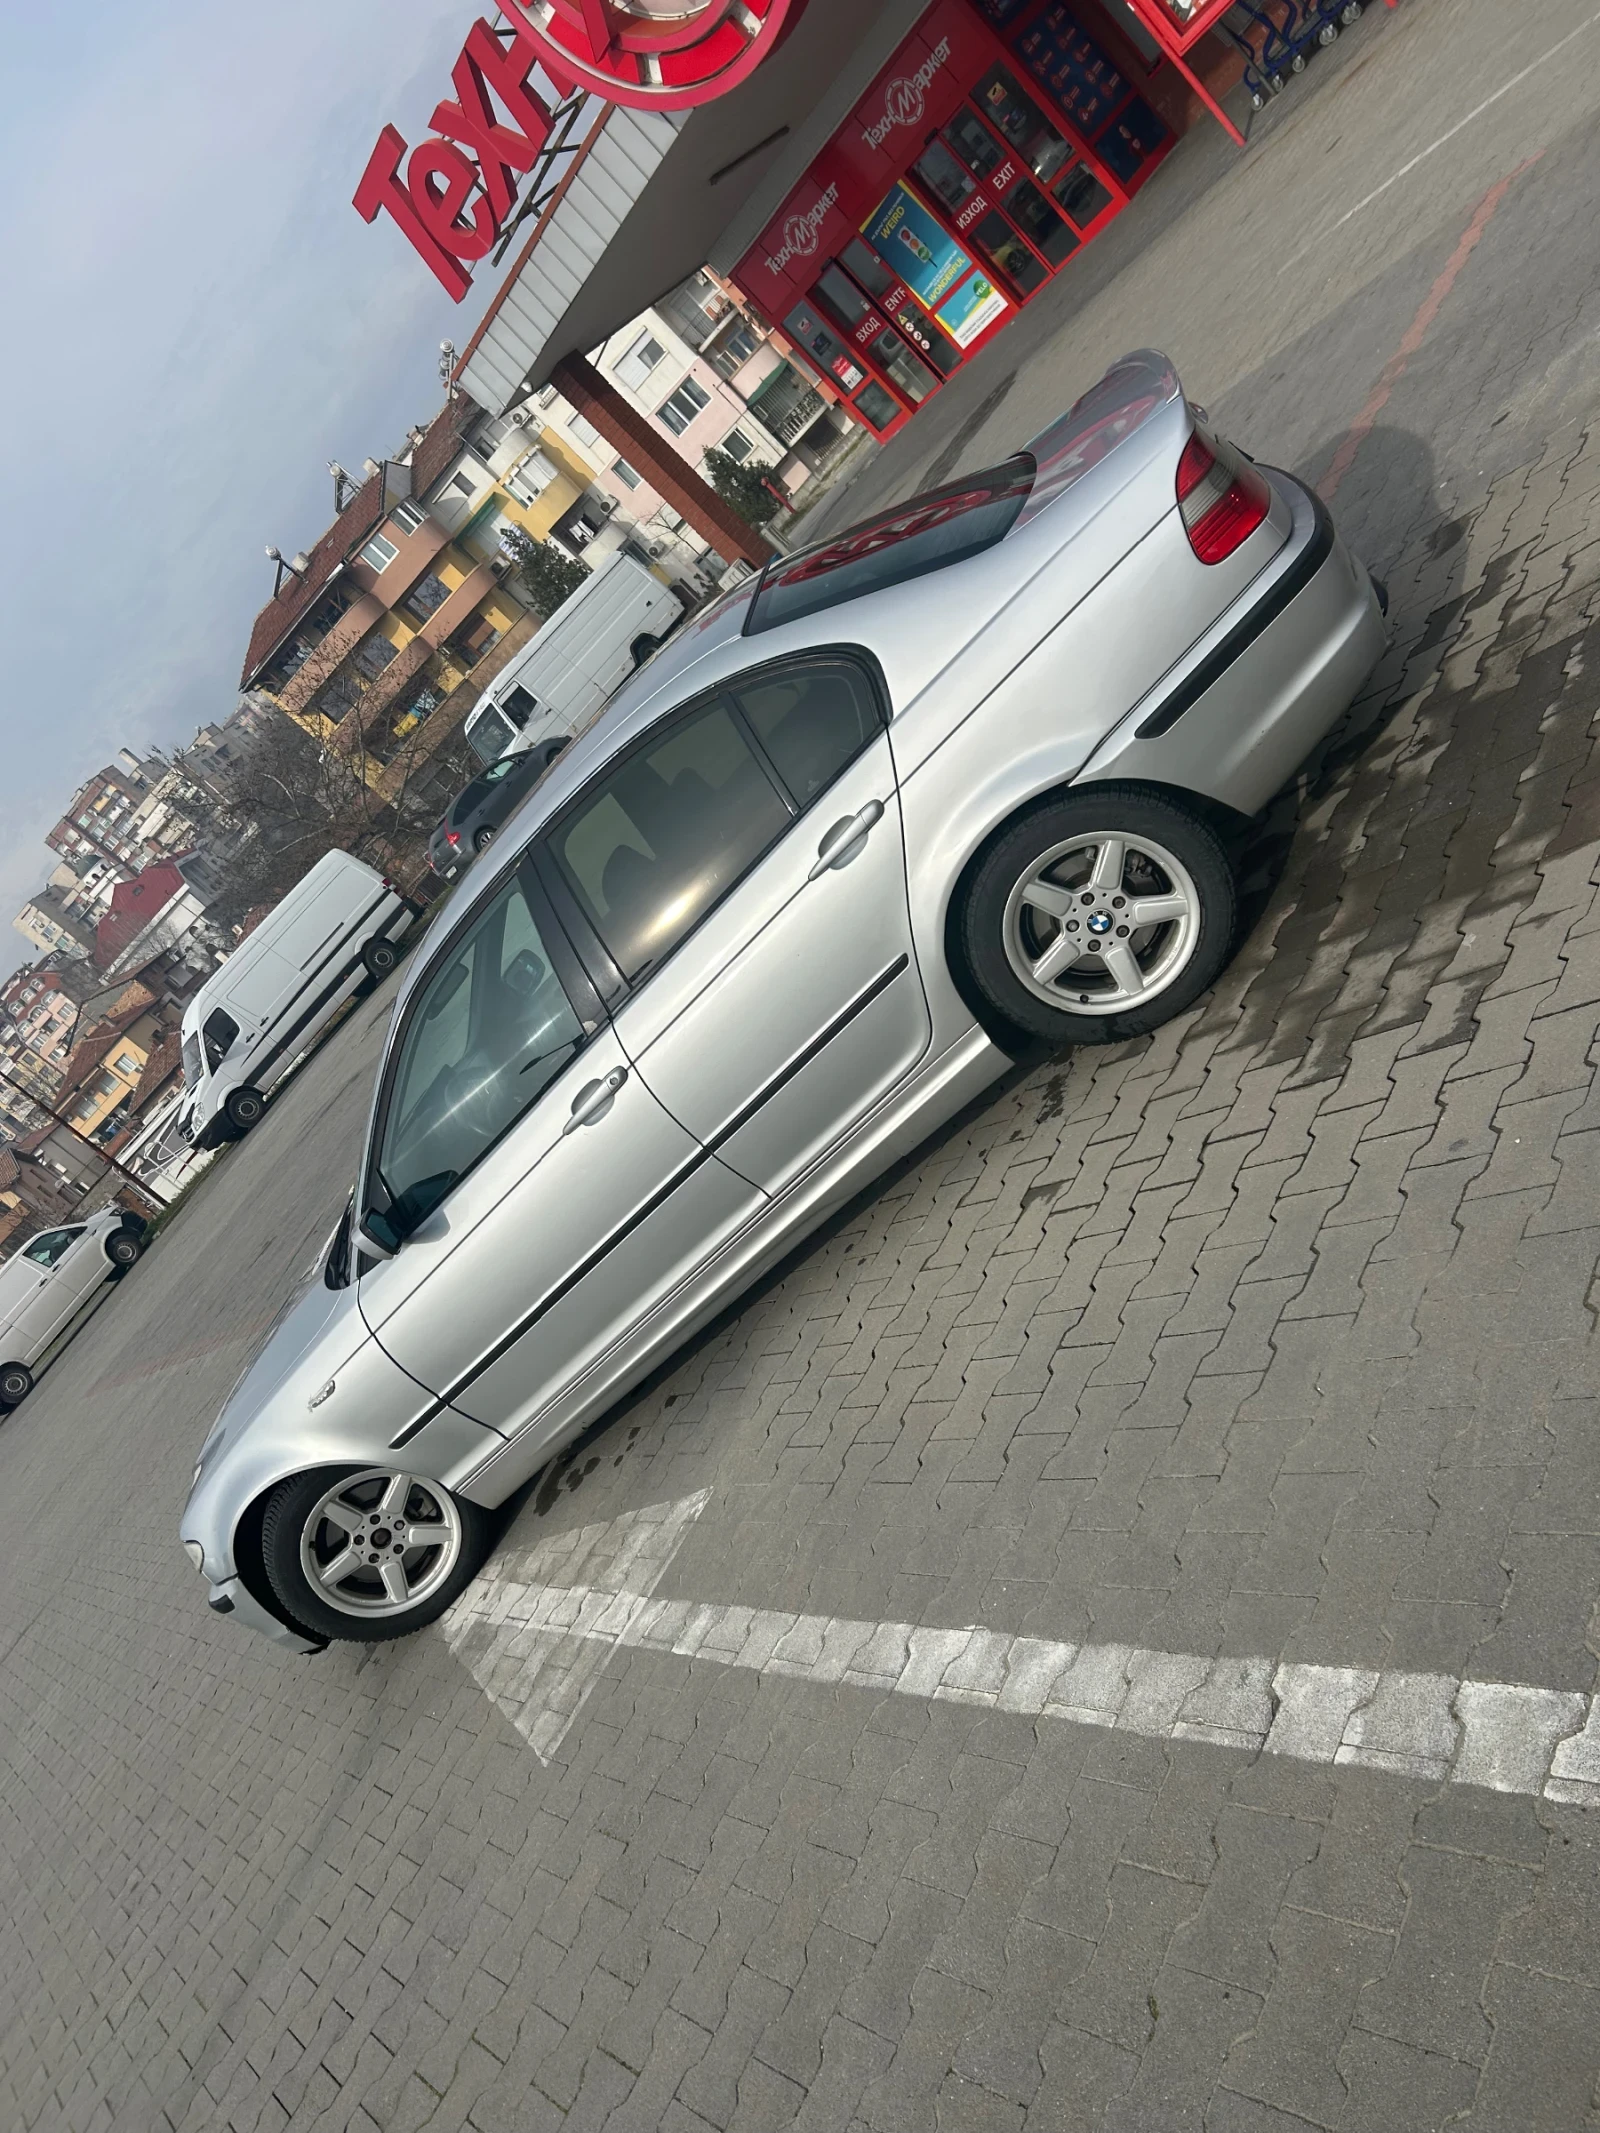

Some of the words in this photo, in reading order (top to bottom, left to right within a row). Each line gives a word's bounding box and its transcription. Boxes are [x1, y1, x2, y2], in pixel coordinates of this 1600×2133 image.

[992, 162, 1016, 190] EXIT
[879, 204, 906, 239] WEIRD
[956, 195, 987, 228] ИЗХОД
[927, 256, 965, 302] WONDERFUL
[855, 316, 881, 342] ВХОД
